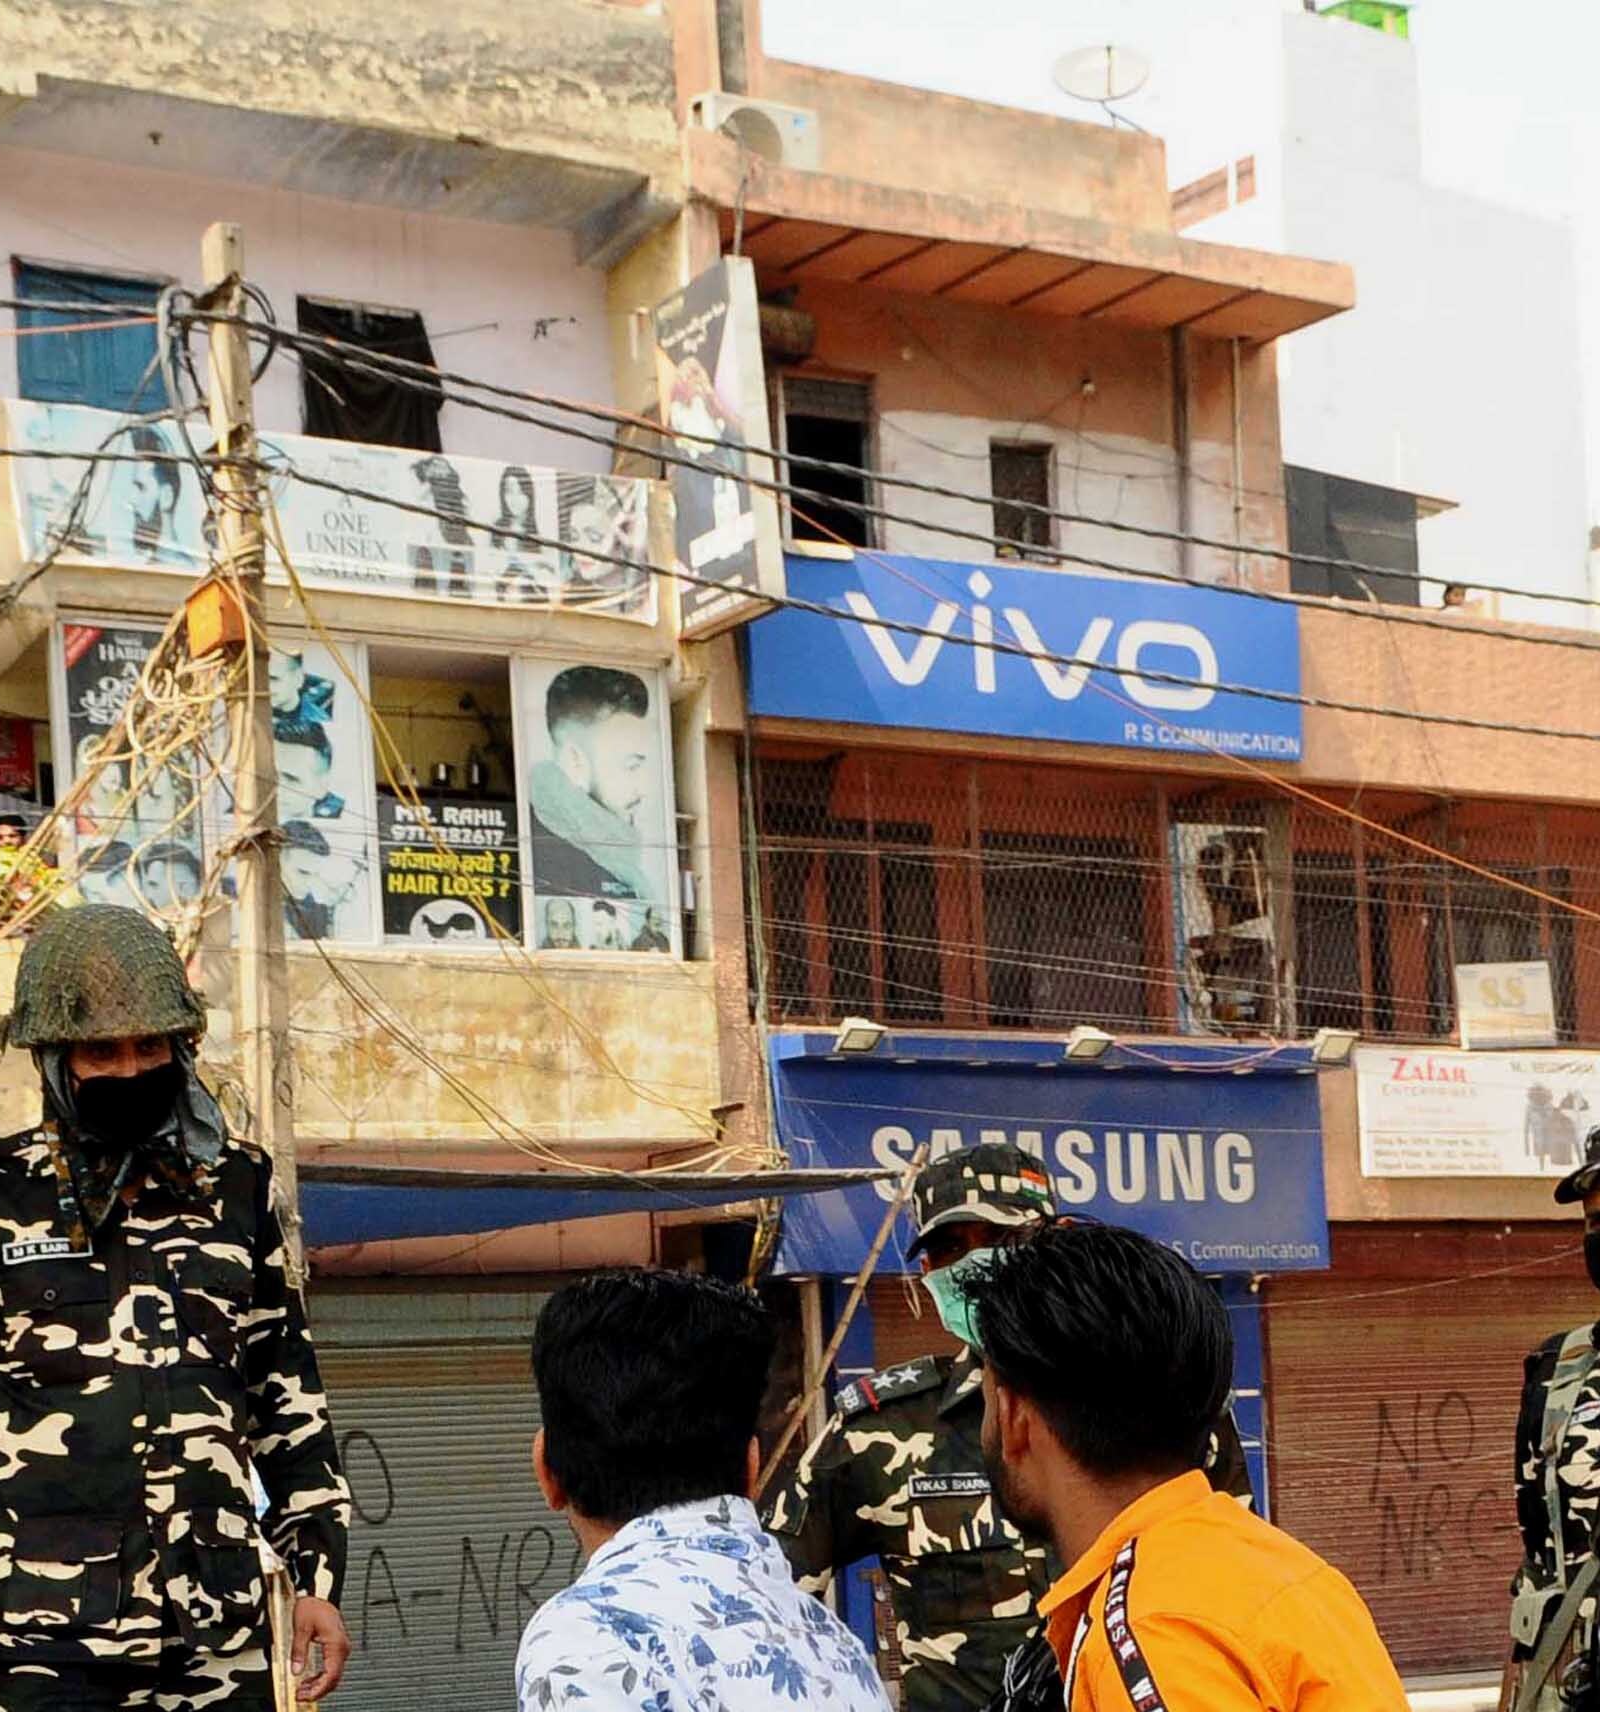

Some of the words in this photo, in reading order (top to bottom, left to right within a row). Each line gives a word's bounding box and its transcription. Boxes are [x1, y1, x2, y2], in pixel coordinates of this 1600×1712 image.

[322, 511, 370, 535] ONE
[306, 531, 389, 561] UNISEX
[844, 569, 1219, 712] vivo
[1123, 722, 1139, 743] R
[1142, 724, 1155, 745] S
[1157, 725, 1300, 756] COMMUNICATION
[442, 806, 507, 827] RAHIL
[387, 873, 439, 895] HAIR
[442, 876, 494, 897] LOSS
[1190, 1239, 1320, 1260] Communication
[1368, 1390, 1475, 1503] NO
[915, 1479, 948, 1492] VIKAS
